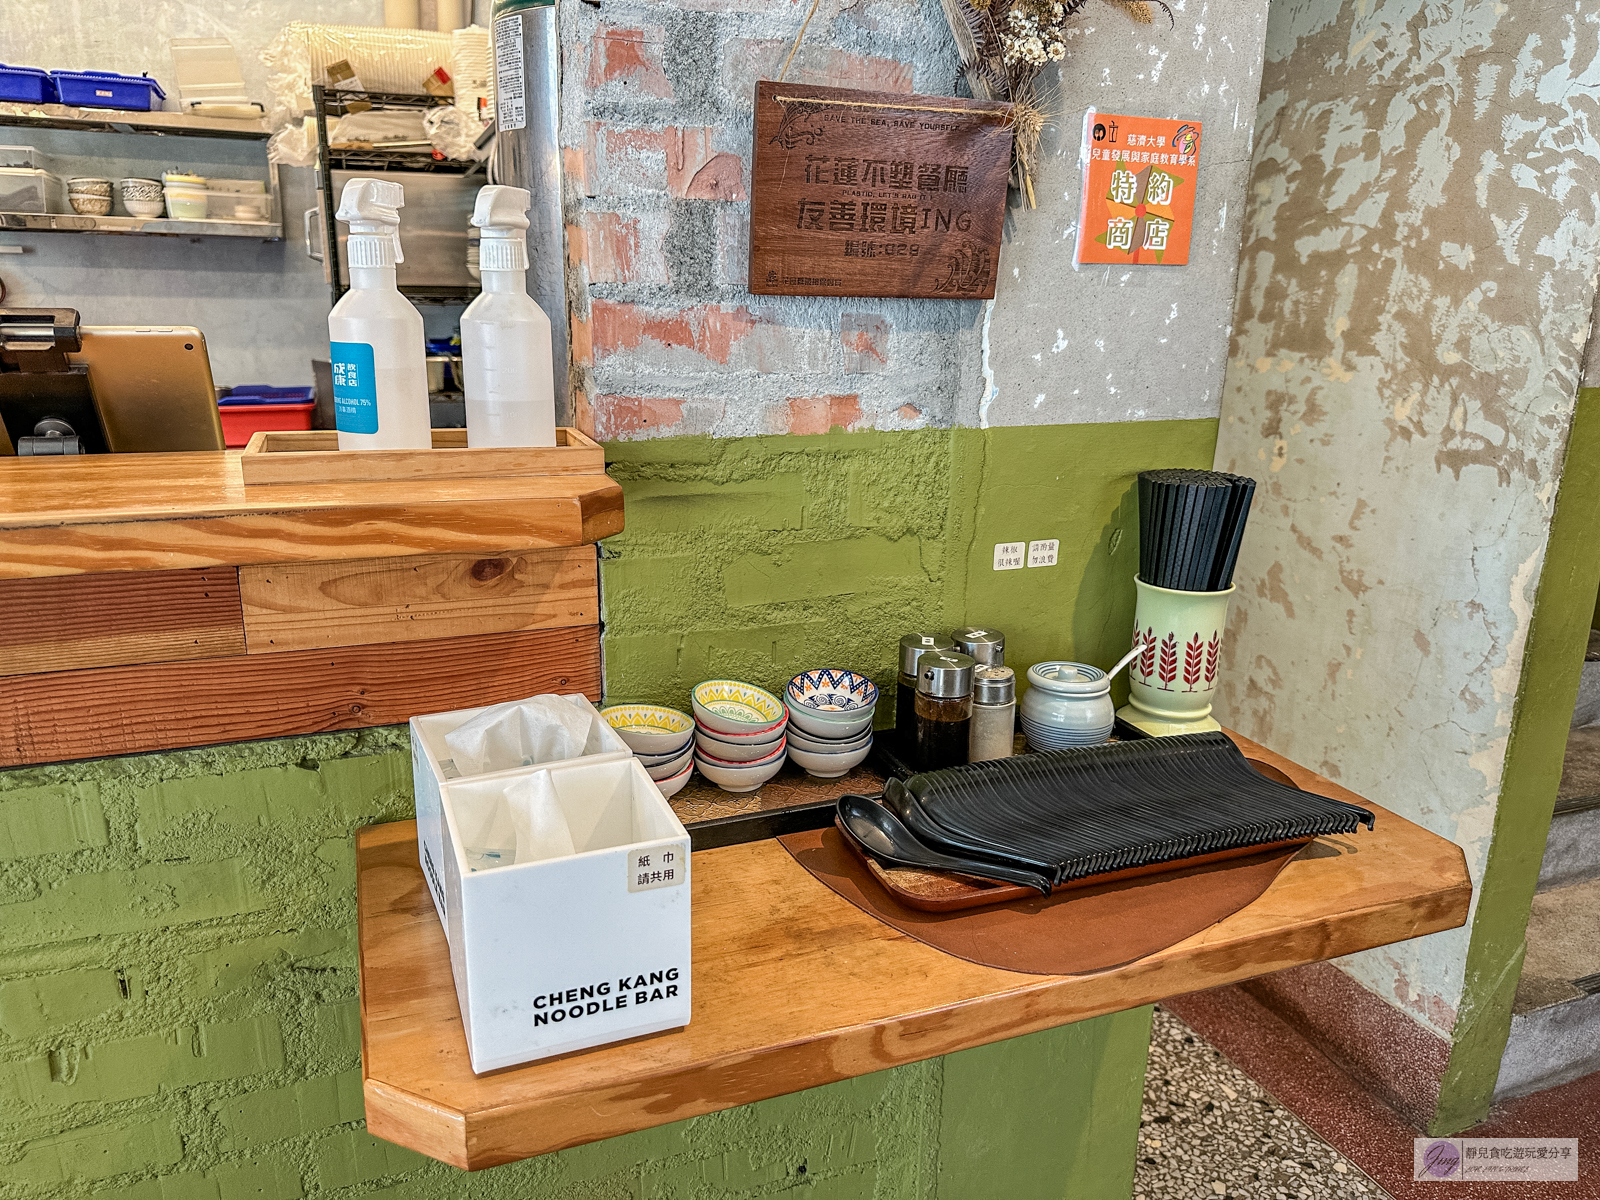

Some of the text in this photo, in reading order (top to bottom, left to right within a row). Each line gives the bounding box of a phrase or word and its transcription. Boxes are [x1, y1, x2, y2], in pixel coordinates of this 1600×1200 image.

[824, 114, 960, 132] SAVE THE SEA, SAVE YOURSELF
[1127, 133, 1166, 148] 慈濟大學
[1091, 147, 1196, 167] 兒童發展與家庭教育學系
[804, 154, 969, 193] 花蓮不塑餐廳
[341, 397, 360, 406] ALCOHOL
[360, 398, 372, 407] 75%
[637, 868, 674, 886] 請共用
[533, 967, 679, 1010] CHENG KANG
[533, 984, 679, 1027] NOODLE BAR
